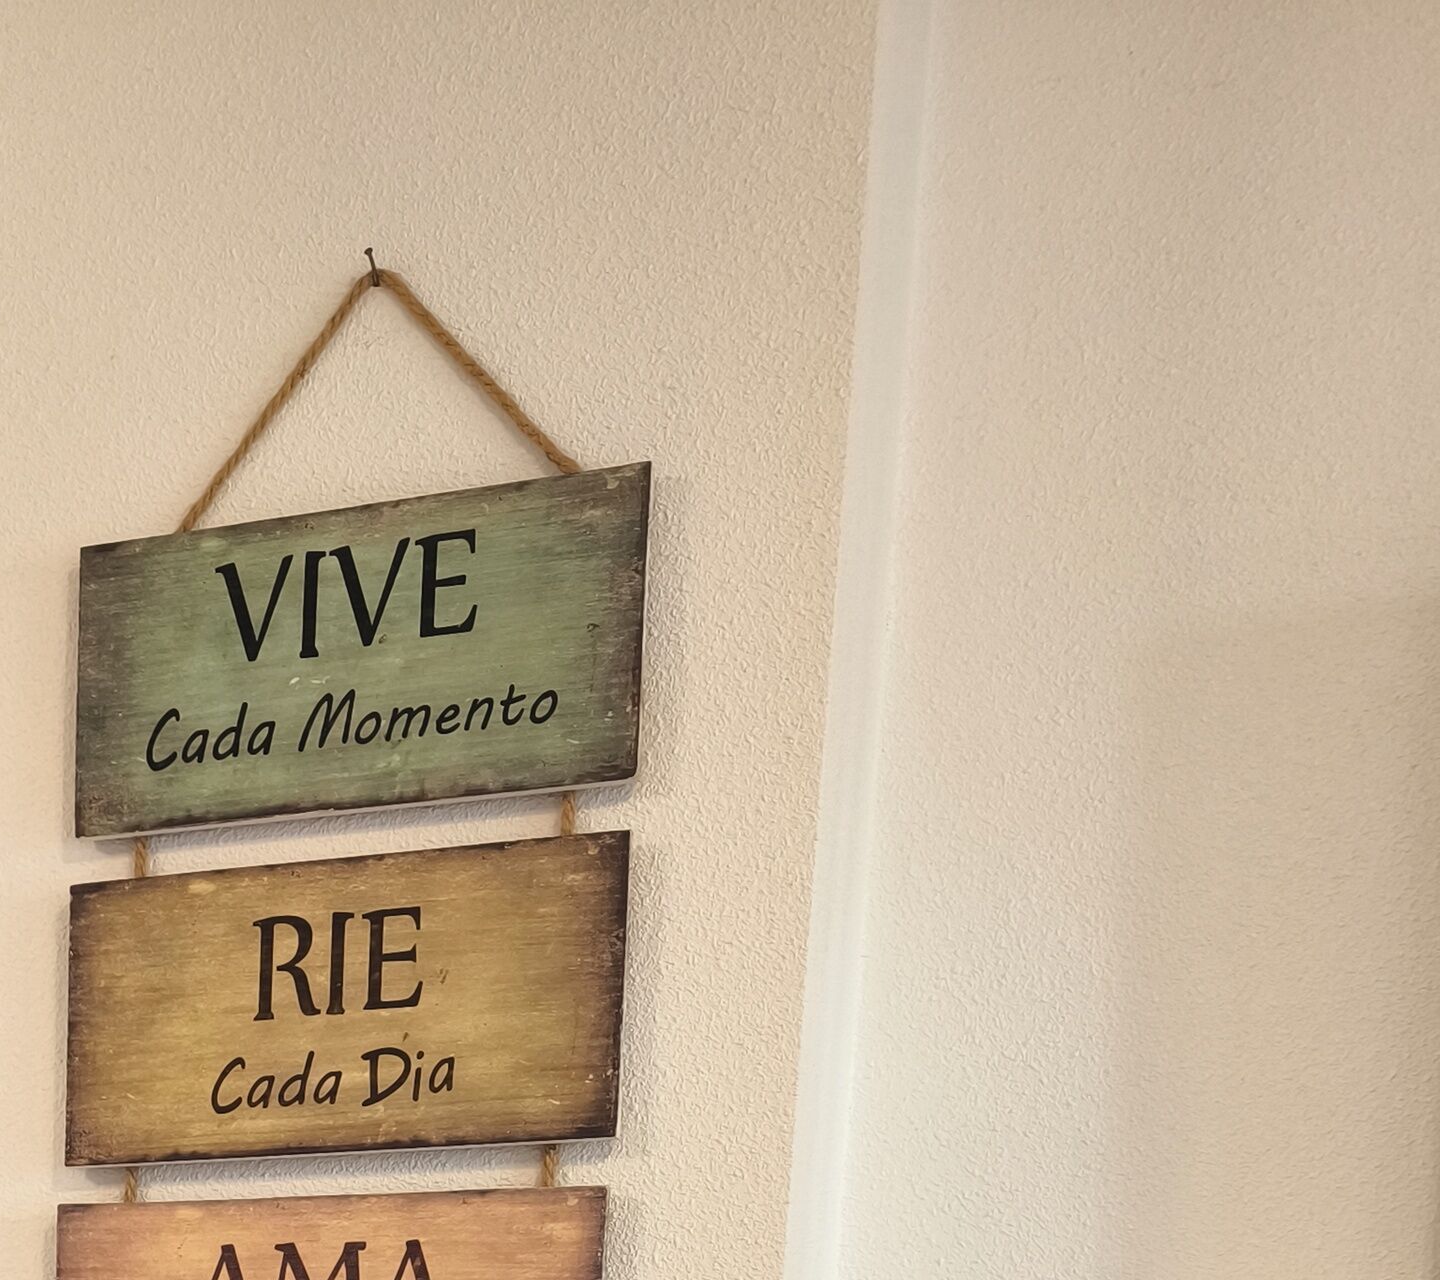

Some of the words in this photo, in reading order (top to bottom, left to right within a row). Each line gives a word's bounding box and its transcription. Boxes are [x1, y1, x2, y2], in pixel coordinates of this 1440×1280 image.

[214, 528, 478, 662] VIVE
[145, 701, 276, 772] Cada
[298, 684, 558, 753] Momento
[252, 906, 424, 1022] RIE
[210, 1051, 343, 1115] Cada
[360, 1045, 456, 1107] Dia
